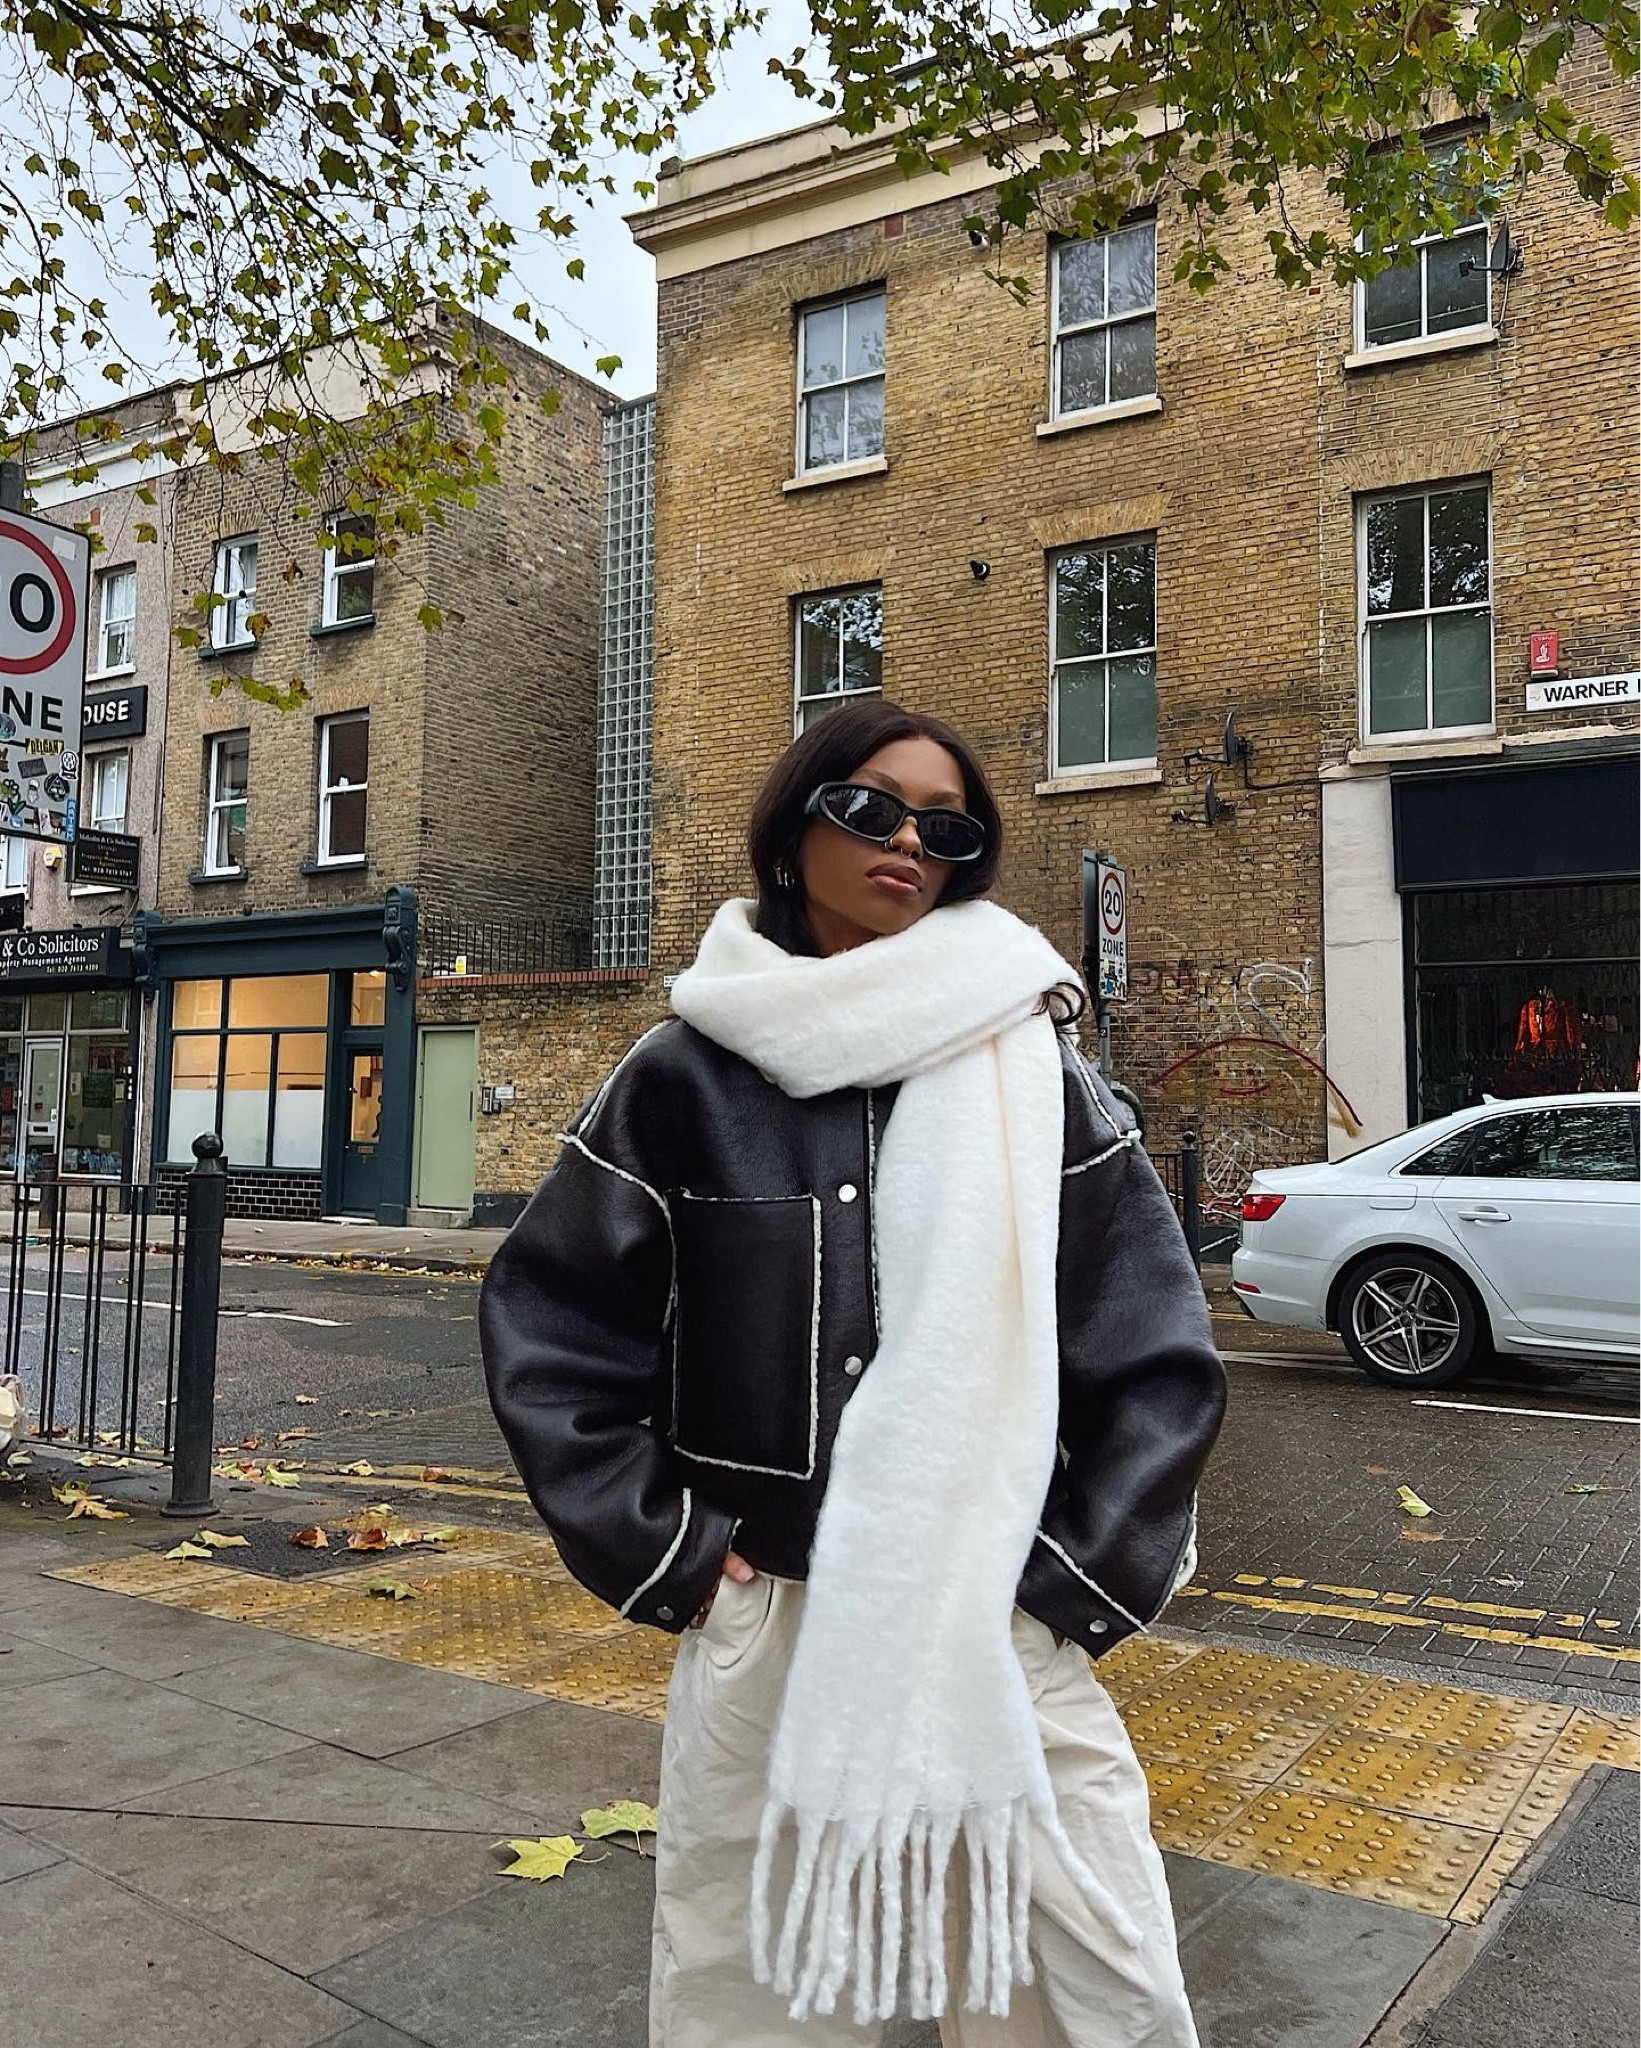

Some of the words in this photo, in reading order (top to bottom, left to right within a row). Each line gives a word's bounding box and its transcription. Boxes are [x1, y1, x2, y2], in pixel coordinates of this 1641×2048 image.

[1544, 680, 1629, 703] WARNER
[1105, 889, 1121, 917] 20
[2, 938, 14, 957] &
[17, 937, 35, 956] Co
[39, 934, 99, 954] Solicitors
[1102, 938, 1124, 957] ZONE
[22, 957, 61, 967] Management
